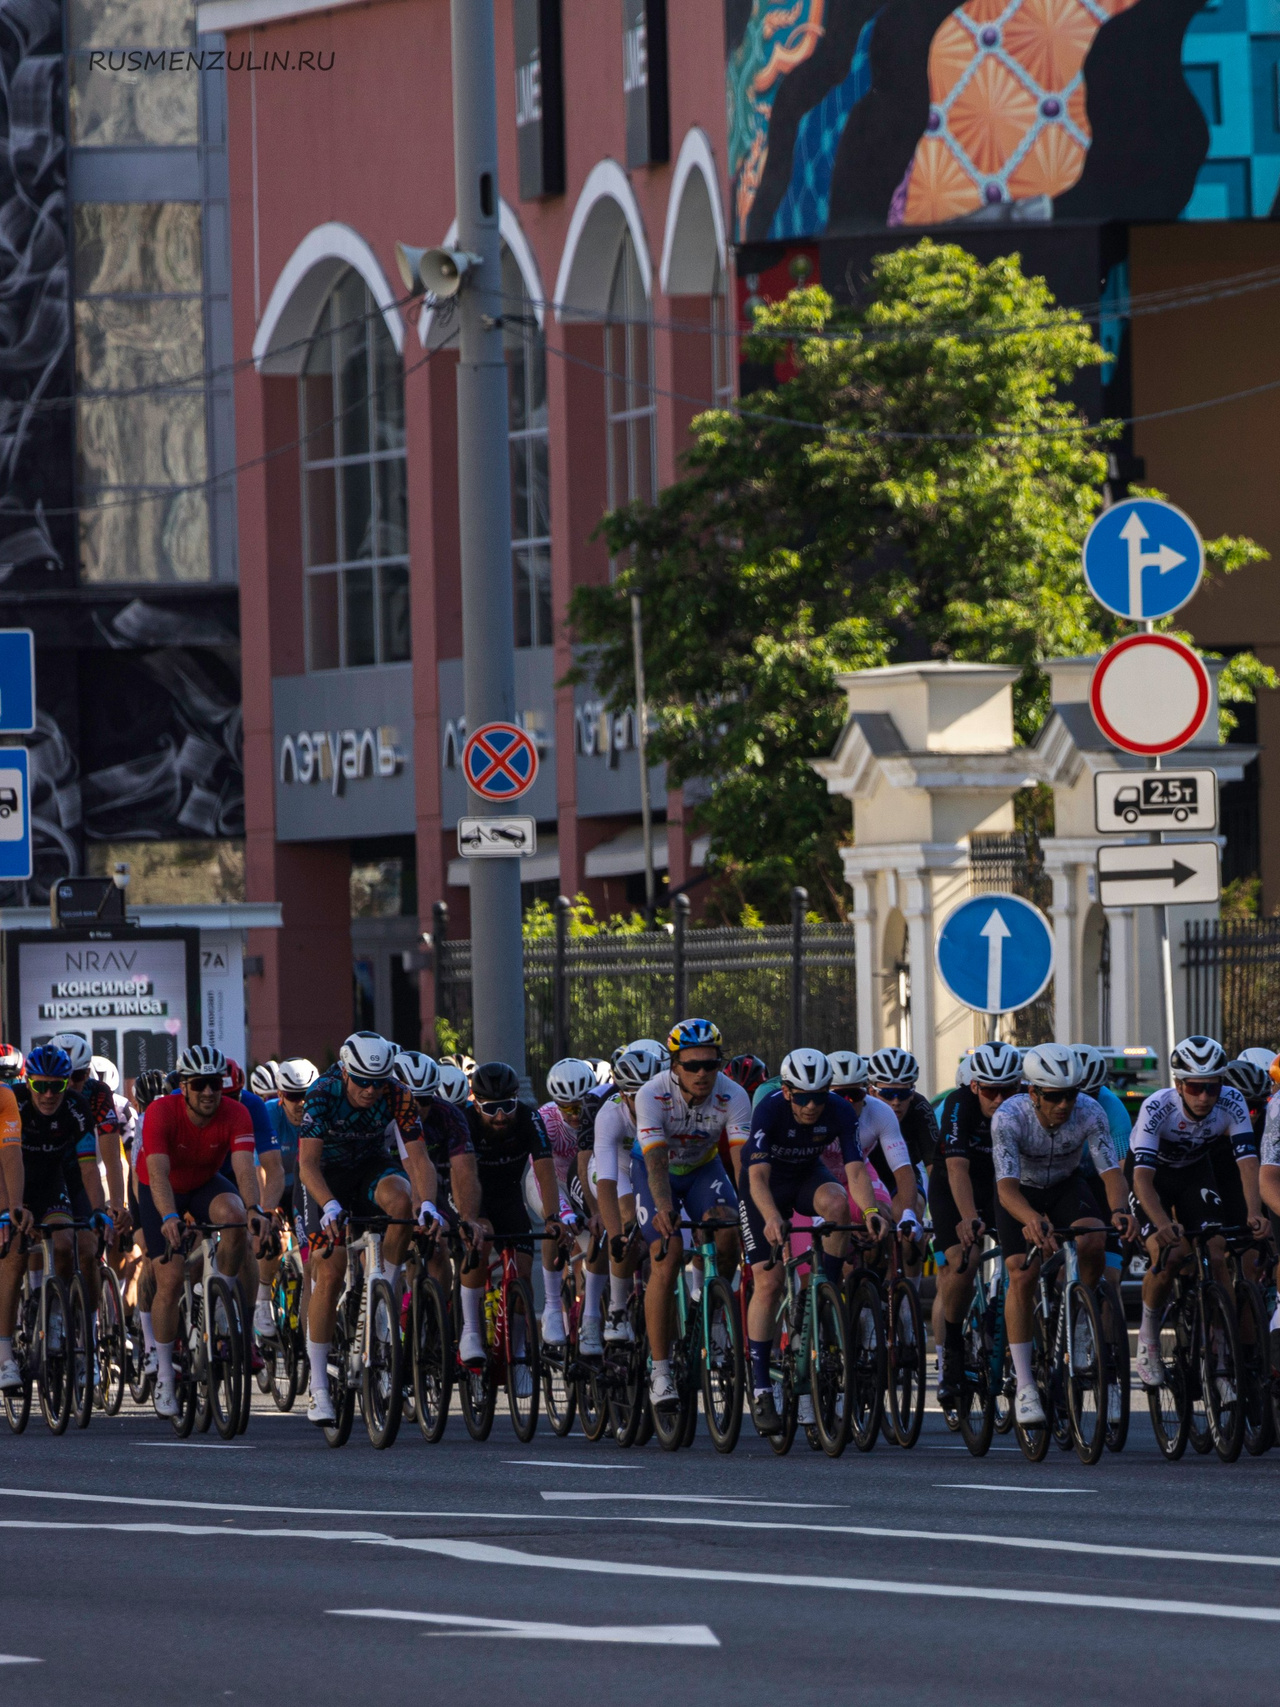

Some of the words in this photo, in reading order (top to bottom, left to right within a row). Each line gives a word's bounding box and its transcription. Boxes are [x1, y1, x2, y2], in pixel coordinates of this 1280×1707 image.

[66, 951, 137, 971] NRAV
[57, 980, 148, 998] консилер
[44, 1001, 110, 1019] просто
[113, 999, 163, 1015] имба
[1143, 1101, 1176, 1135] Капитал
[1216, 1096, 1246, 1124] апитал
[738, 1199, 757, 1252] SERPANTIN
